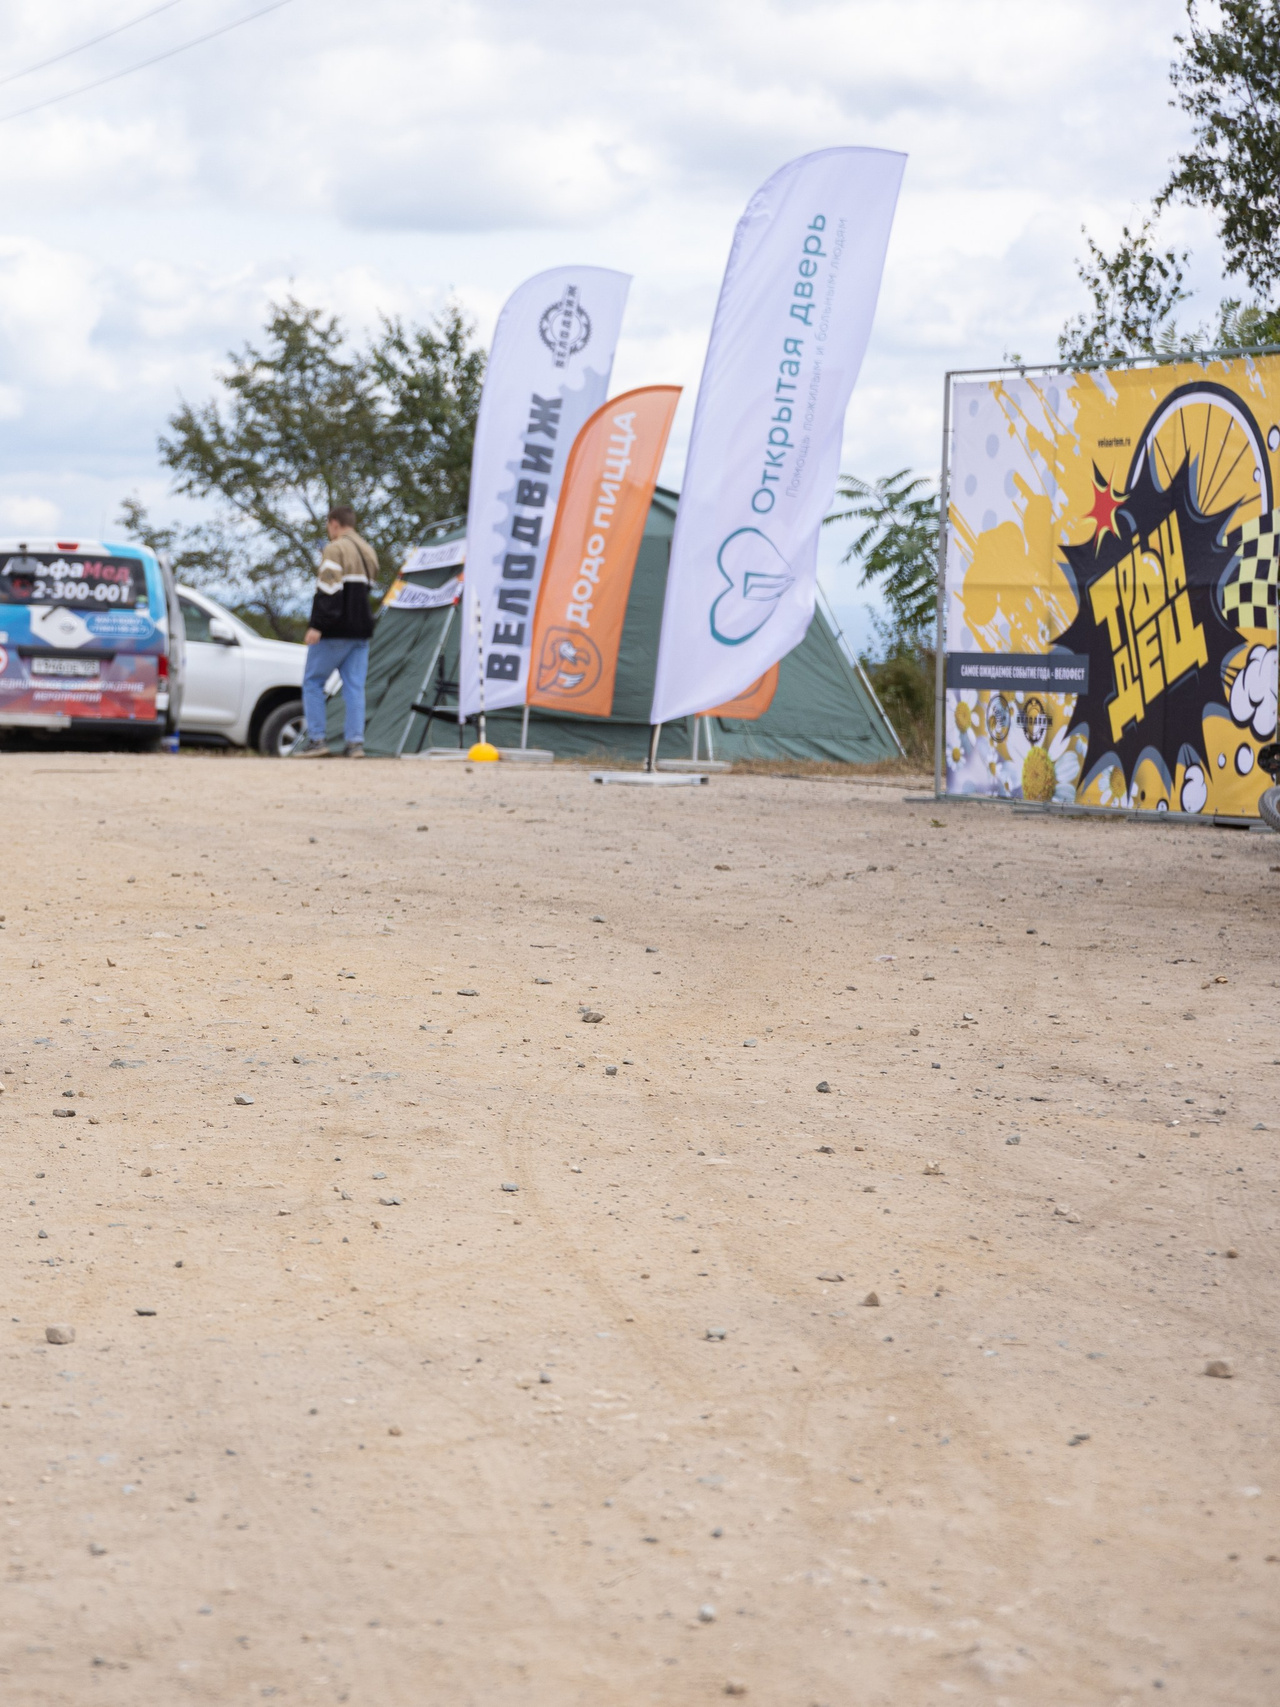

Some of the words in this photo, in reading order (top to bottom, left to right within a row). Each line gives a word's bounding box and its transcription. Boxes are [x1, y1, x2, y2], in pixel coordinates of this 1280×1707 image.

[751, 337, 804, 515] Открытая
[790, 214, 827, 326] дверь
[31, 580, 130, 603] 2-300-001
[486, 393, 563, 682] ВЕЛОДВИЖ
[566, 533, 606, 628] ДОДО
[593, 411, 637, 529] ПИЦЦА
[1055, 667, 1086, 681] ВЕЛОФЕСТ
